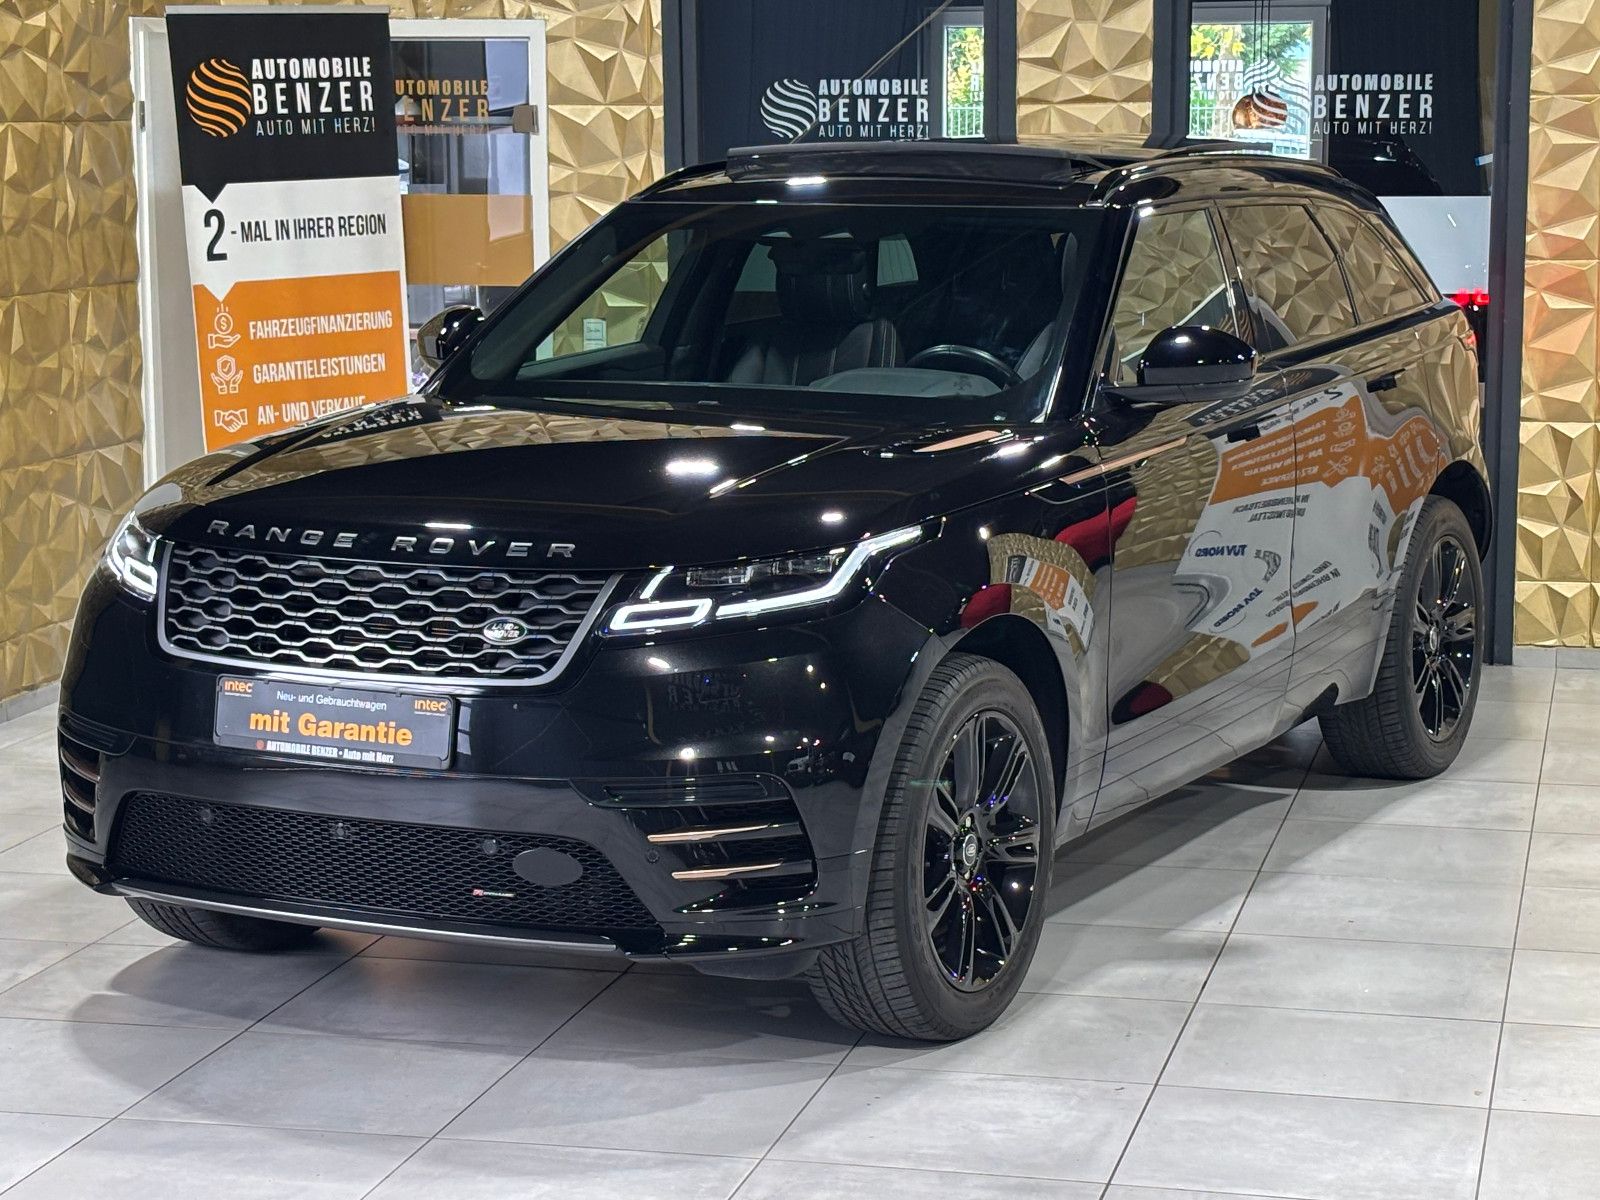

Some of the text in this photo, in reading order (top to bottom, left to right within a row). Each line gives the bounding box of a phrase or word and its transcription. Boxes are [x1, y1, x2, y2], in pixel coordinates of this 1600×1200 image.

[251, 56, 372, 79] AUTOMOBILE
[395, 79, 488, 96] UTOMOBILE
[818, 78, 929, 96] AUTOMOBILE
[1314, 73, 1433, 91] AUTOMOBILE
[252, 80, 374, 115] BENZER
[1313, 93, 1433, 119] BENZER
[403, 98, 489, 122] ENZER
[818, 98, 929, 123] BENZER
[256, 116, 376, 136] AUTO MIT HERZ!
[818, 125, 929, 139] AUTO MIT HERZ!
[1313, 121, 1433, 135] AUTO MIT HERZ!
[204, 208, 228, 262] 2
[240, 220, 272, 243] MAL
[275, 219, 290, 241] IN
[293, 216, 335, 240] IHRER
[338, 213, 387, 237] REGION
[249, 310, 393, 340] FAHRZEUGFINANZIERUNG
[253, 353, 386, 384] GARANTIELEISTUNGEN
[257, 405, 280, 426] AN-
[282, 403, 310, 424] UND
[206, 519, 577, 558] RANGE ROVER
[224, 680, 253, 694] intec
[276, 690, 387, 712] Neu- und Gebrauchtwagen
[414, 699, 448, 712] intec
[249, 709, 413, 746] mit Garantie
[266, 740, 394, 764] AUTOMOBILE BENZER Auto mit Herz
